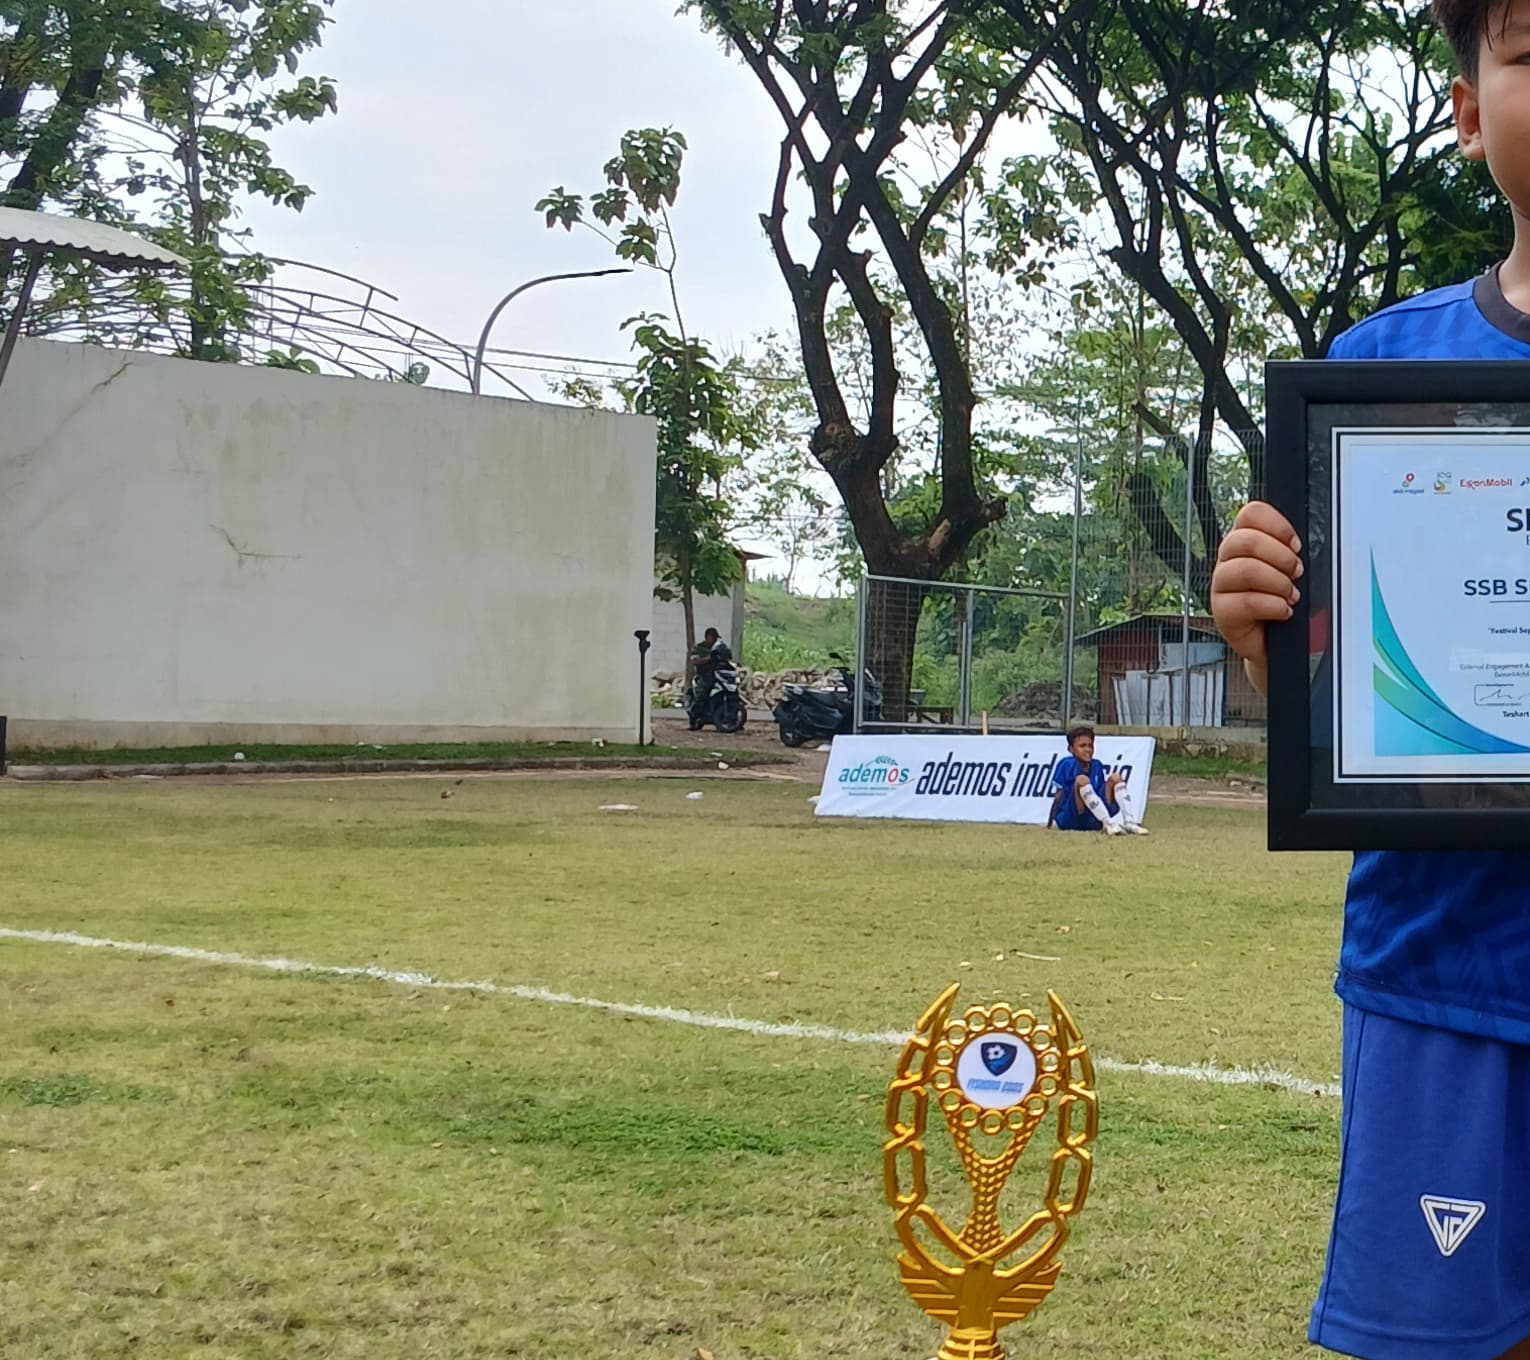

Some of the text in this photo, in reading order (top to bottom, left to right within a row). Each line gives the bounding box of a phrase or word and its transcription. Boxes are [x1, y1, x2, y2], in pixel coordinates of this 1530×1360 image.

[1460, 479, 1513, 489] ExxonMobil
[1463, 579, 1508, 596] SSB
[838, 762, 909, 782] ademos
[914, 751, 1012, 798] ademos
